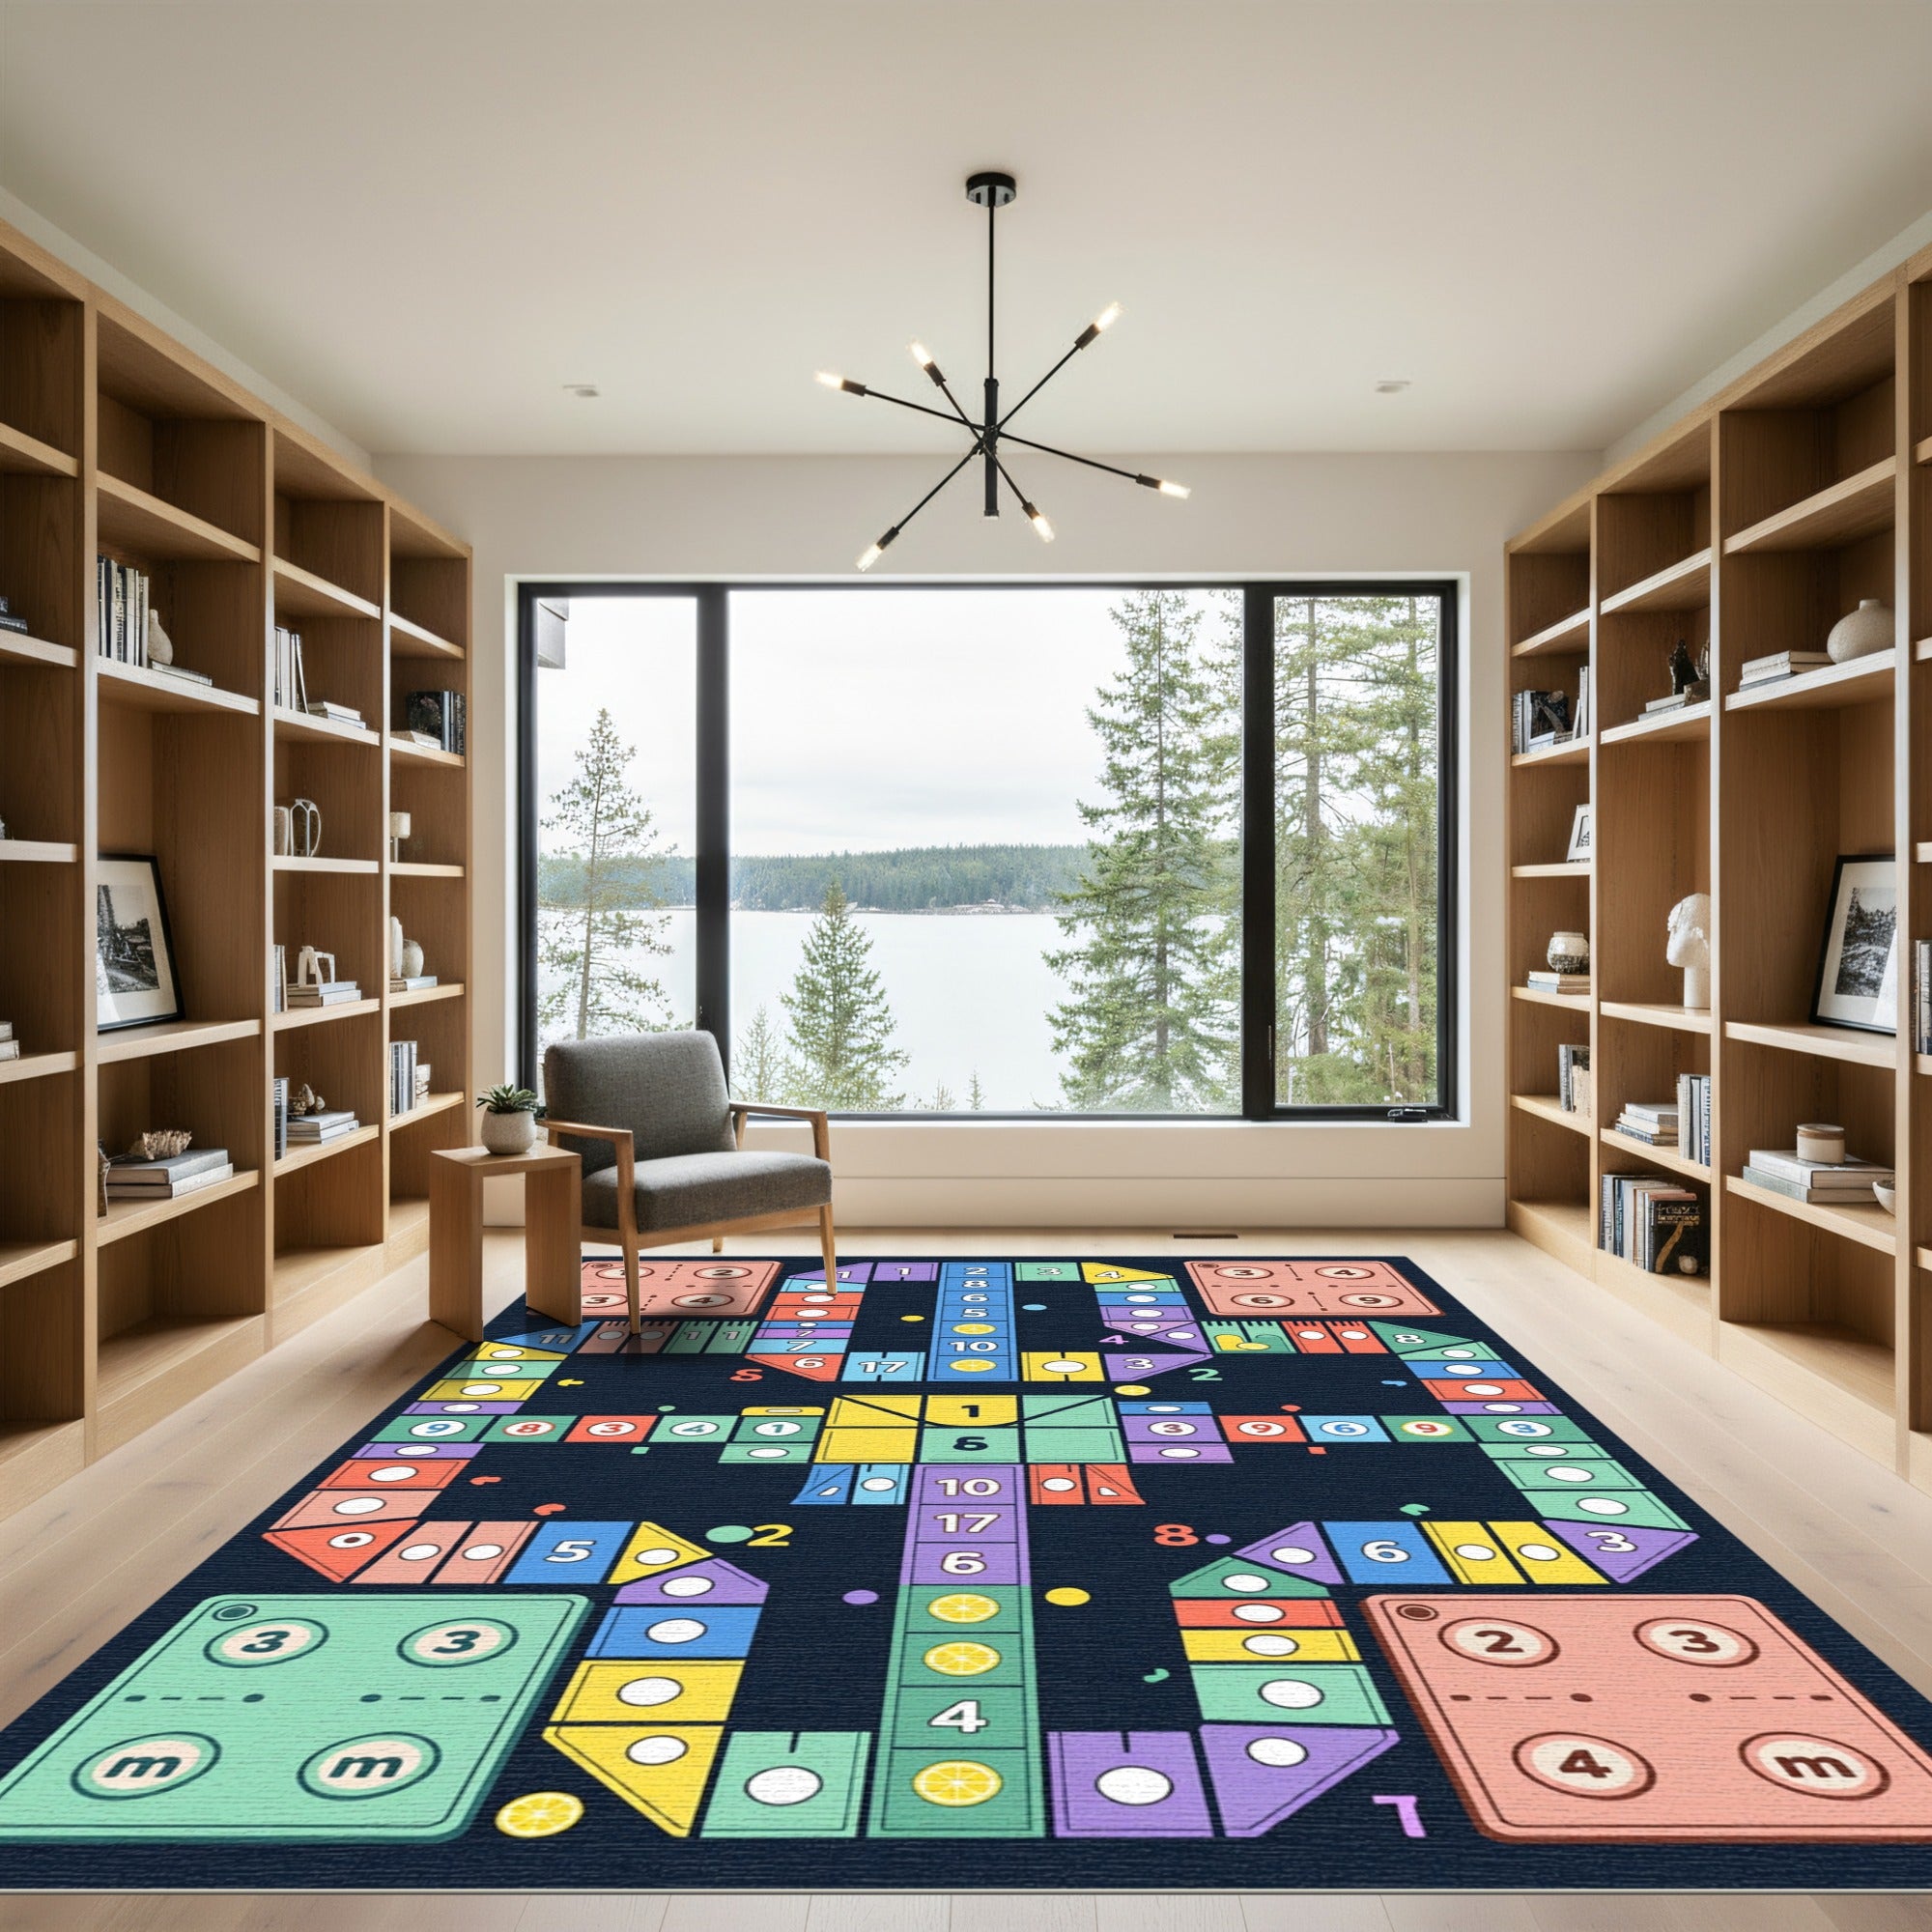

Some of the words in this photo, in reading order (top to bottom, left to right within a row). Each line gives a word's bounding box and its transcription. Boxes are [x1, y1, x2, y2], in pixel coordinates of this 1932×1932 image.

[964, 1266, 989, 1275] 2
[1037, 1267, 1062, 1276] 3
[1095, 1270, 1124, 1280] 4
[962, 1279, 989, 1288] 8
[961, 1293, 989, 1302] 6
[960, 1308, 989, 1318] 5
[1098, 1334, 1129, 1346] 4
[1394, 1333, 1426, 1345] 8
[786, 1341, 816, 1351] 7
[948, 1341, 999, 1352] 10
[793, 1356, 826, 1369] 6
[858, 1360, 909, 1373] 17
[1123, 1358, 1154, 1370] 3
[1188, 1368, 1223, 1381] 2
[961, 1405, 980, 1417] 1
[426, 1423, 451, 1434] 9
[517, 1422, 541, 1434] 8
[600, 1424, 623, 1433] 3
[682, 1423, 708, 1434] 4
[771, 1423, 785, 1434] 1
[1162, 1423, 1184, 1435] 3
[1250, 1423, 1273, 1435] 9
[1335, 1422, 1354, 1435] 6
[1413, 1423, 1436, 1435] 9
[934, 1476, 1002, 1498] 10
[933, 1512, 1002, 1535] 17
[747, 1523, 794, 1547] 2
[1154, 1523, 1199, 1547] 8
[1584, 1530, 1638, 1553] 3
[544, 1539, 597, 1564] 5
[1360, 1539, 1411, 1564] 6
[939, 1550, 987, 1576] 6
[241, 1630, 290, 1654] 3
[432, 1630, 482, 1654] 3
[1473, 1630, 1524, 1654] 2
[1669, 1630, 1720, 1654] 3
[927, 1699, 988, 1734] 4
[1558, 1748, 1612, 1778] 4
